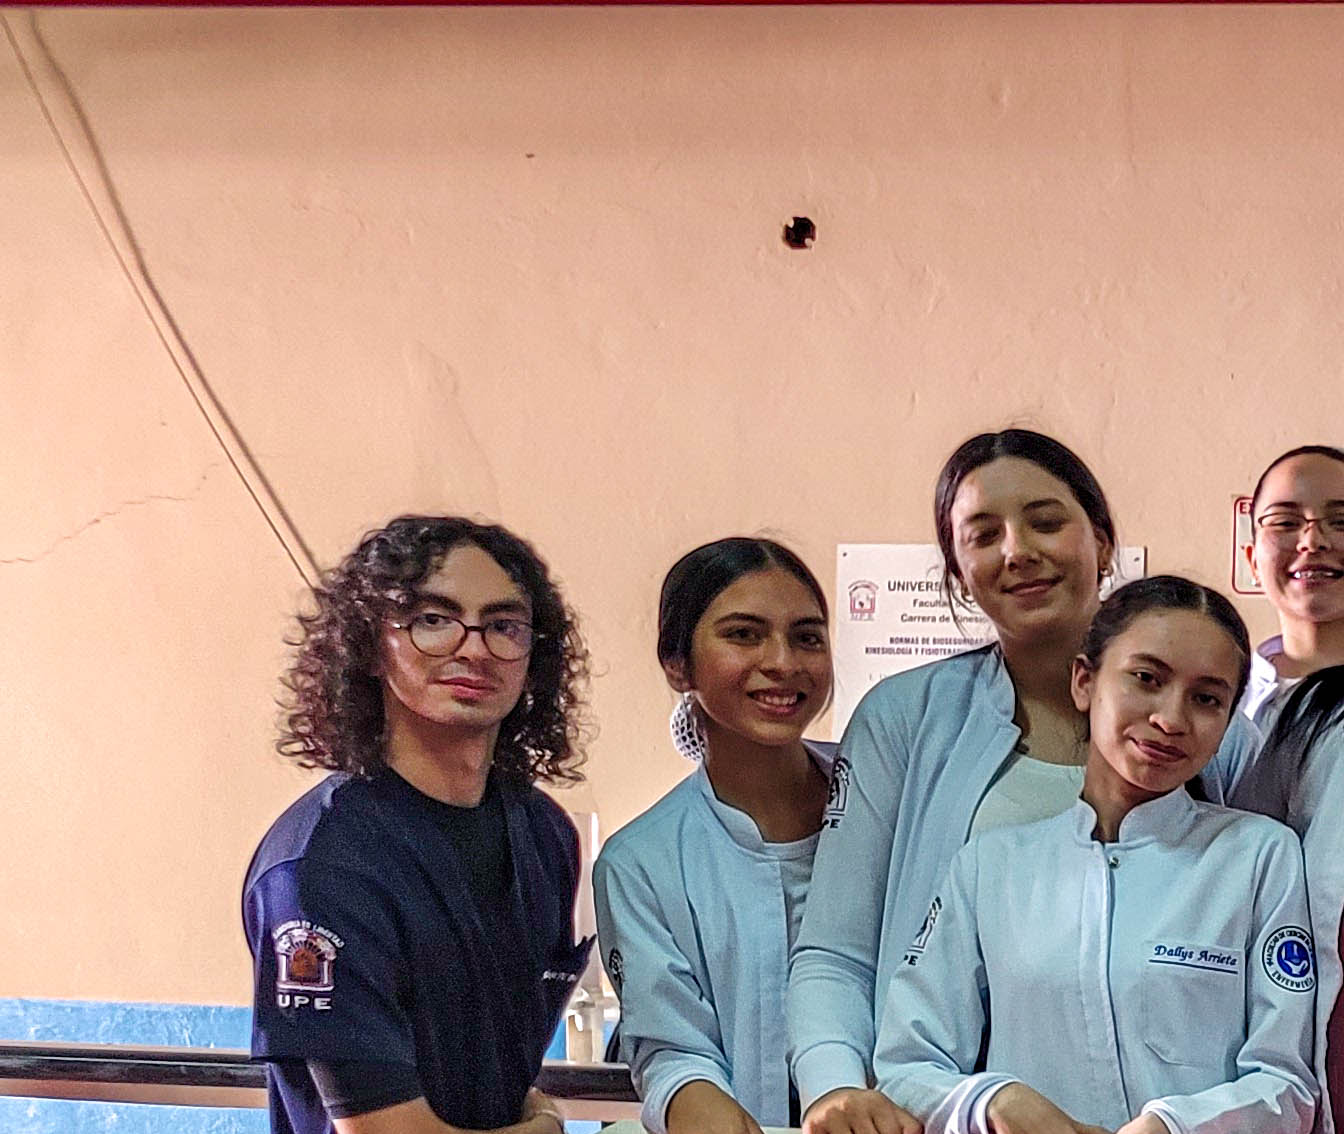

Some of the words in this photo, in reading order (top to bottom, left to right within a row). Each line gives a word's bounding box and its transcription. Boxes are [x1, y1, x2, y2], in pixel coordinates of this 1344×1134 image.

[887, 580, 941, 592] UNIVERS
[900, 613, 936, 623] Carrera
[939, 613, 950, 623] de
[889, 636, 919, 645] NORMAS
[921, 636, 930, 645] DE
[914, 647, 919, 655] Y
[1154, 945, 1194, 961] Dallys
[278, 994, 333, 1010] UPE
